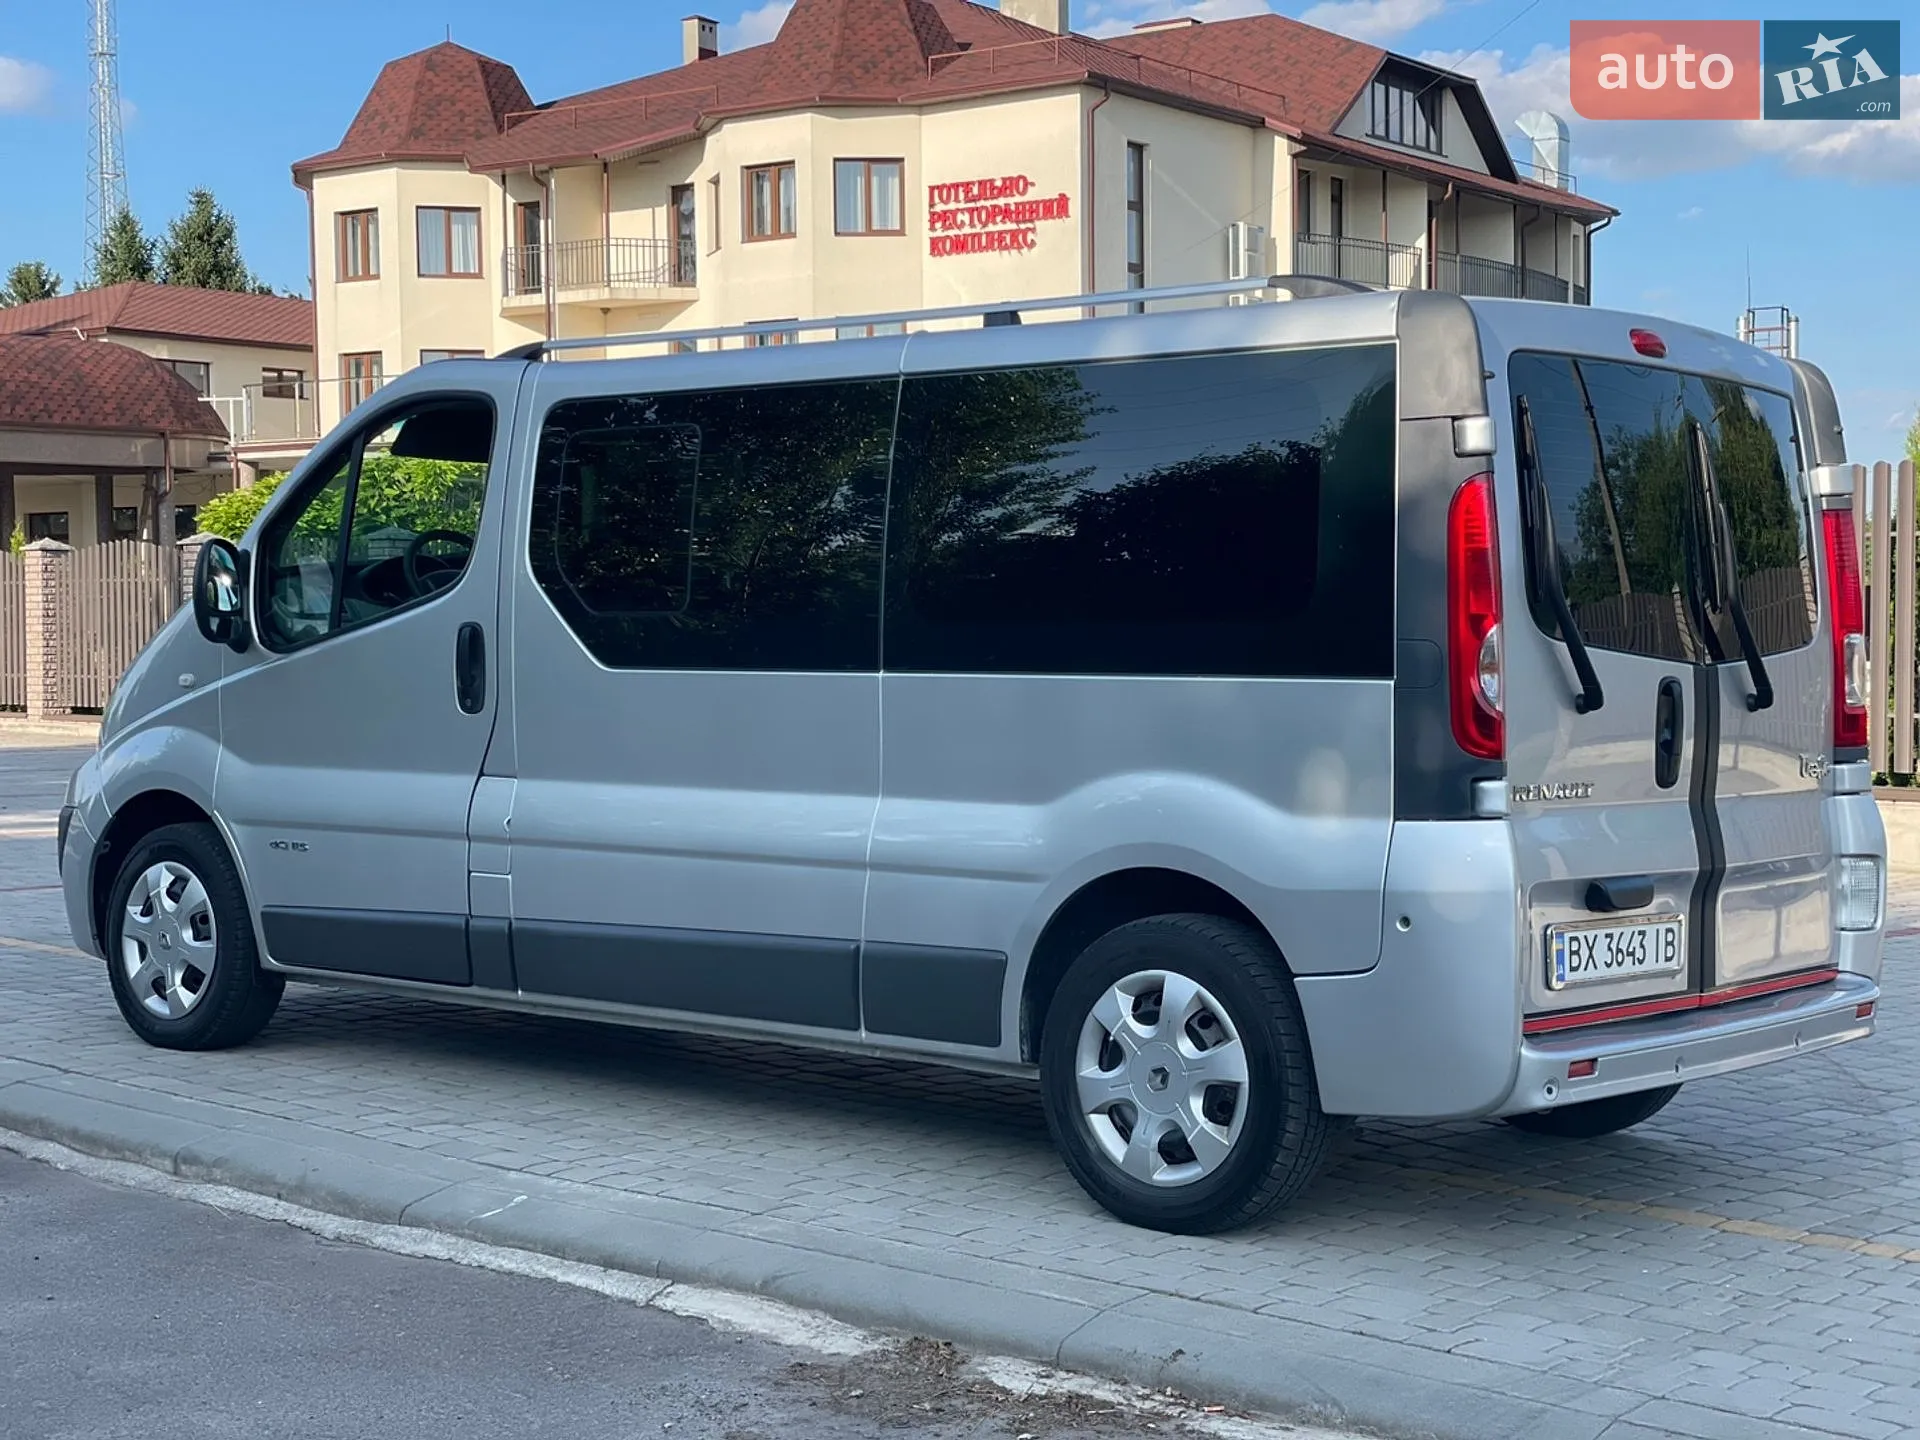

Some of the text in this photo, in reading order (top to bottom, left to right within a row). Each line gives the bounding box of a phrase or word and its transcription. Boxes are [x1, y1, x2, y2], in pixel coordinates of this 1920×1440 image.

[928, 174, 1036, 208] ГОТЕЛЬНО-
[928, 193, 1071, 232] РЕСТОРАННИЙ
[929, 226, 1037, 257] КОМПЛЕКС
[1512, 782, 1595, 802] RENAULT
[1568, 933, 1599, 973] BX
[1603, 929, 1647, 969] 3643
